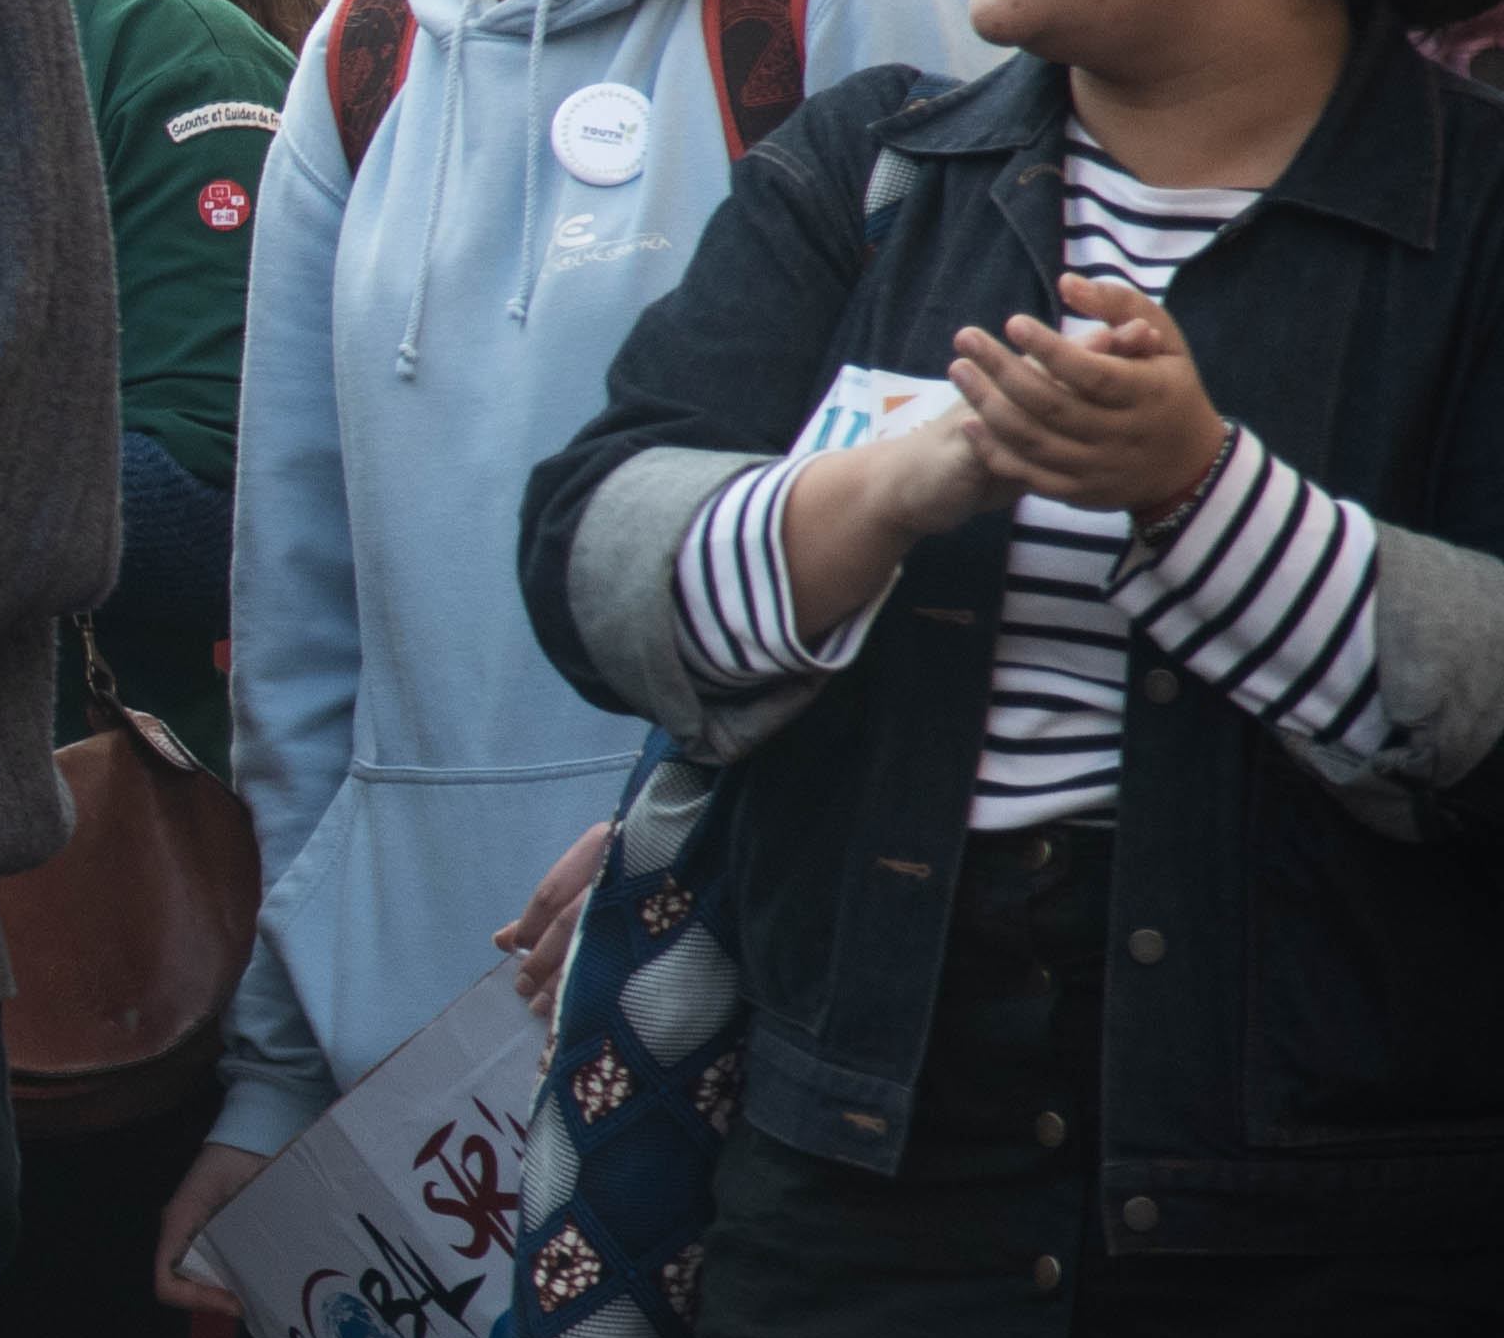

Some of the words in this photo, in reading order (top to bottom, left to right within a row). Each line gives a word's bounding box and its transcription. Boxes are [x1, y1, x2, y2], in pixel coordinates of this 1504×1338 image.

[171, 113, 209, 138] Scouts
[211, 107, 223, 123] et
[224, 107, 257, 122] Guides
[258, 109, 268, 125] de
[582, 125, 623, 140] YOUTH
